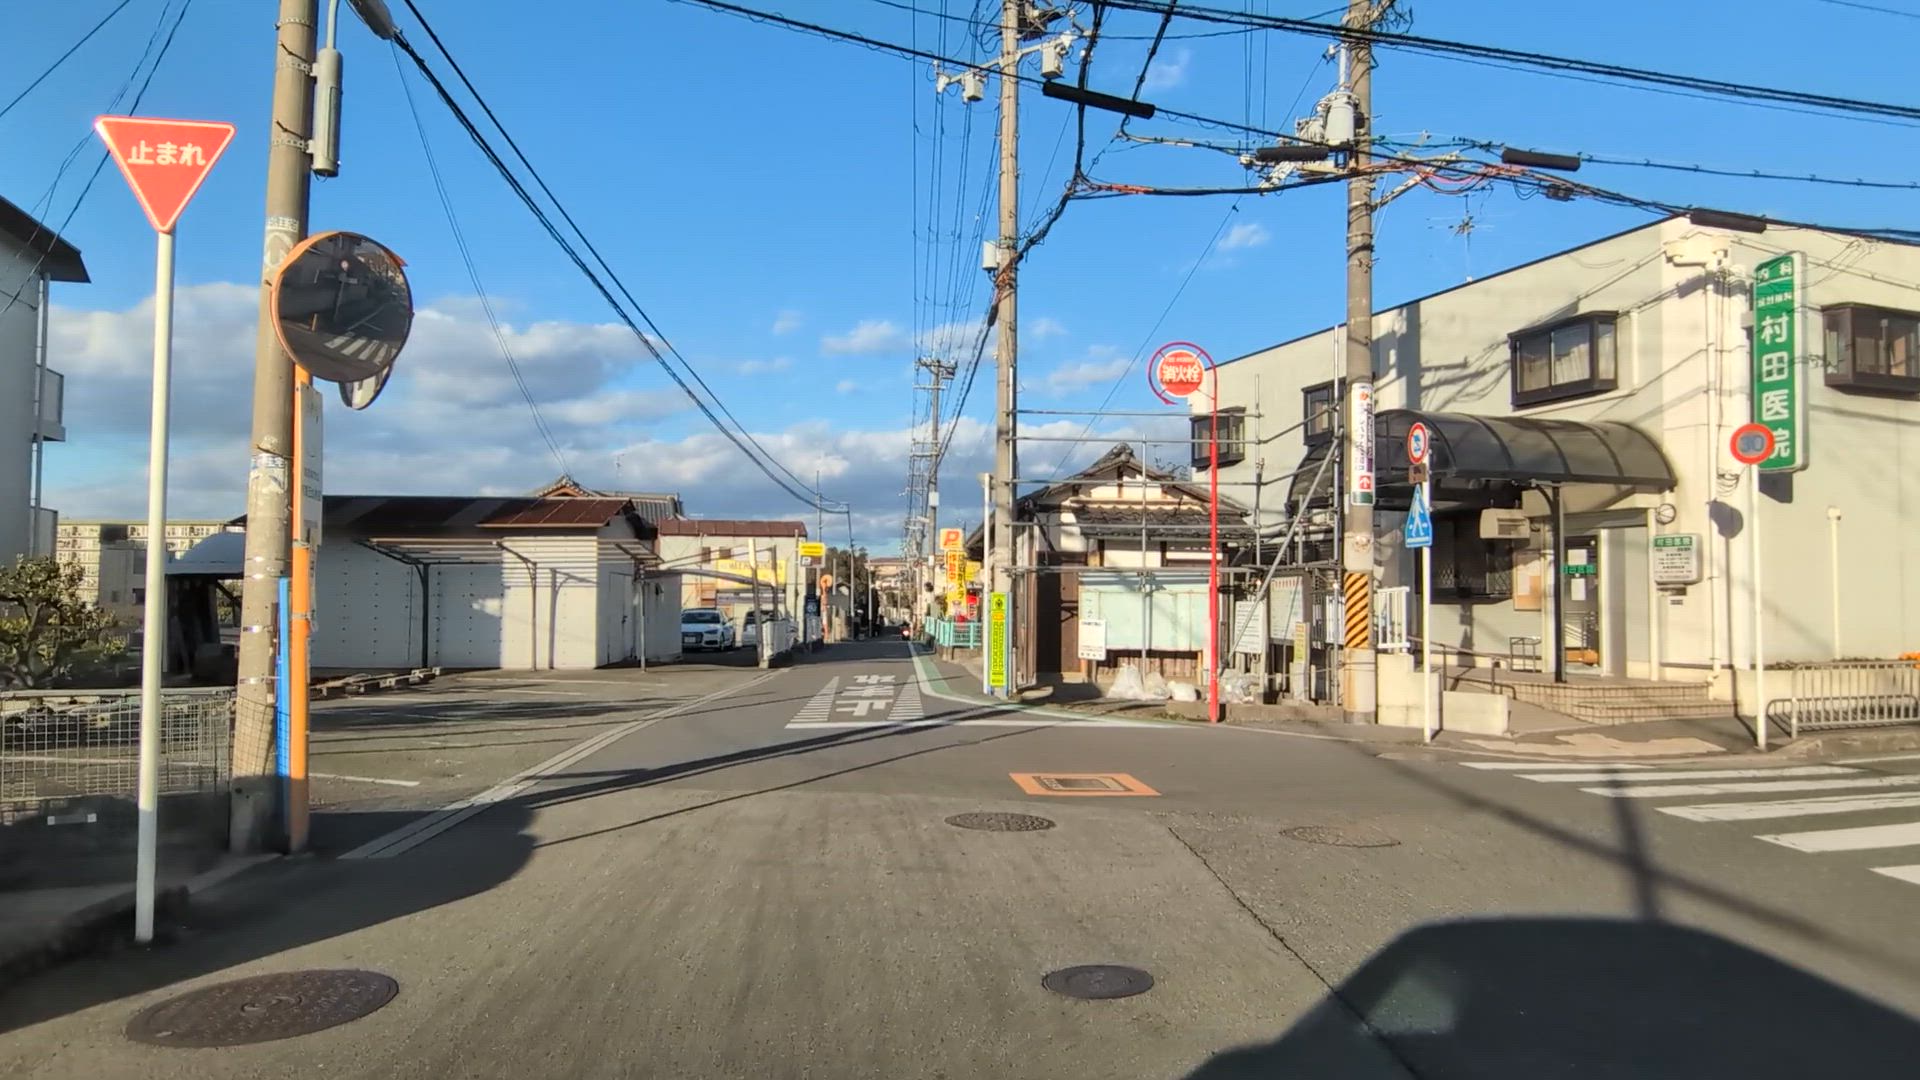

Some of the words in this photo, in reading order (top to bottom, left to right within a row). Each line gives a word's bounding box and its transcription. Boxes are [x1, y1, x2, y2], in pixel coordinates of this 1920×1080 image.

[127, 140, 207, 167] 止まれ
[1162, 364, 1200, 383] 消火栓
[1760, 313, 1791, 459] 村田医院
